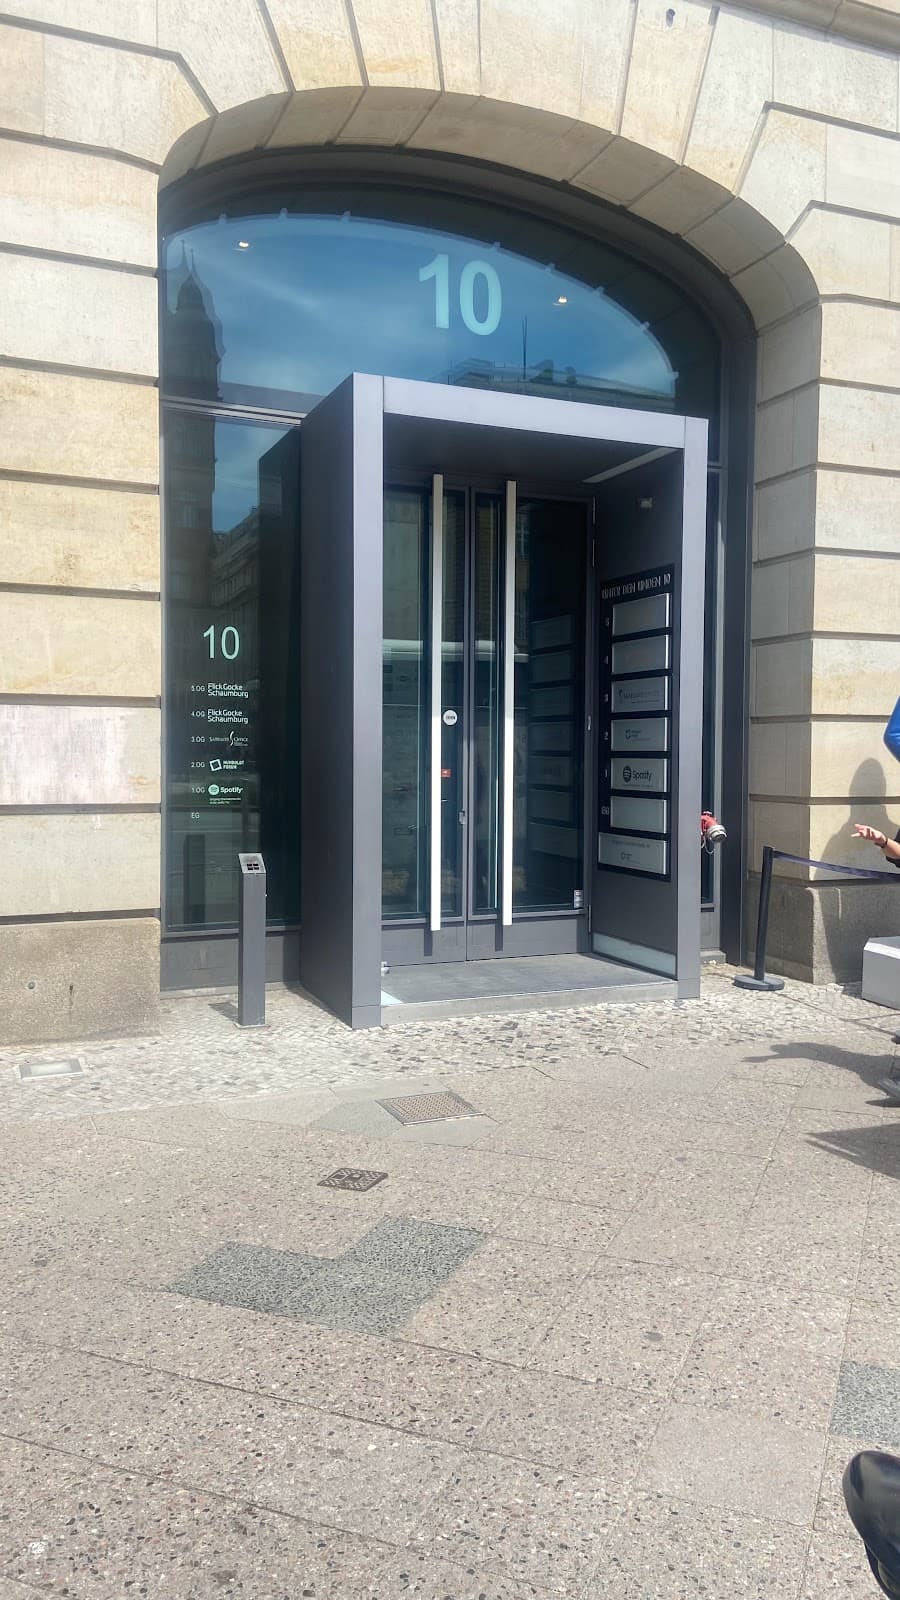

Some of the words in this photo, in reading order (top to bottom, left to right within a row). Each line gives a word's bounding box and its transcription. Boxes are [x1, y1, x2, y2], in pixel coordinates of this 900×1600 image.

[419, 253, 502, 336] 10
[663, 573, 671, 586] 10
[203, 624, 240, 660] 10
[207, 689, 249, 699] Schaumburg
[207, 708, 222, 717] Flick
[222, 709, 243, 717] Gocke
[207, 715, 249, 725] Schaumburg
[632, 769, 652, 781] Spotify
[220, 786, 243, 794] Spotify
